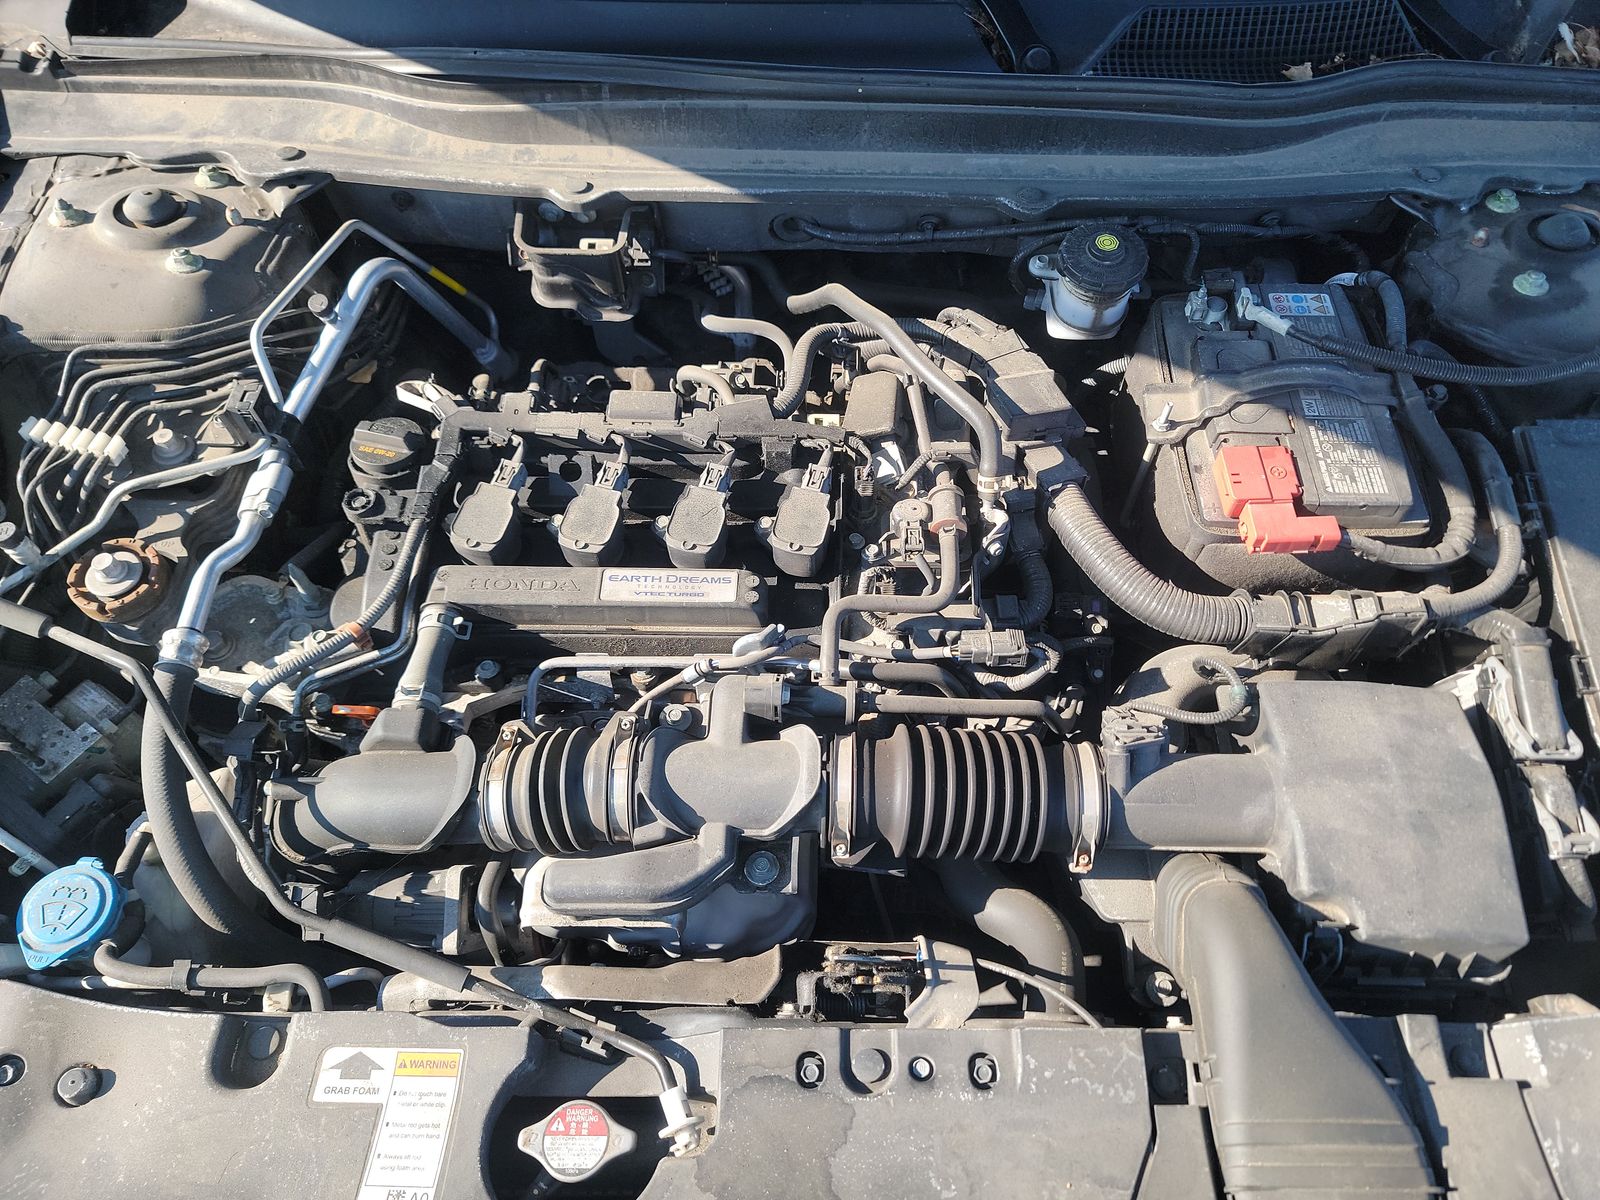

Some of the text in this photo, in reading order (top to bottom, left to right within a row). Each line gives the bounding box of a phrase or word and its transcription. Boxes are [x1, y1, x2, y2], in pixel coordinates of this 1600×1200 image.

[358, 445, 374, 453] SAE
[608, 574, 732, 584] EARTH DREAMS
[469, 578, 581, 592] HONDA
[409, 1059, 457, 1070] WARNING
[323, 1086, 380, 1096] GRAB FOAM
